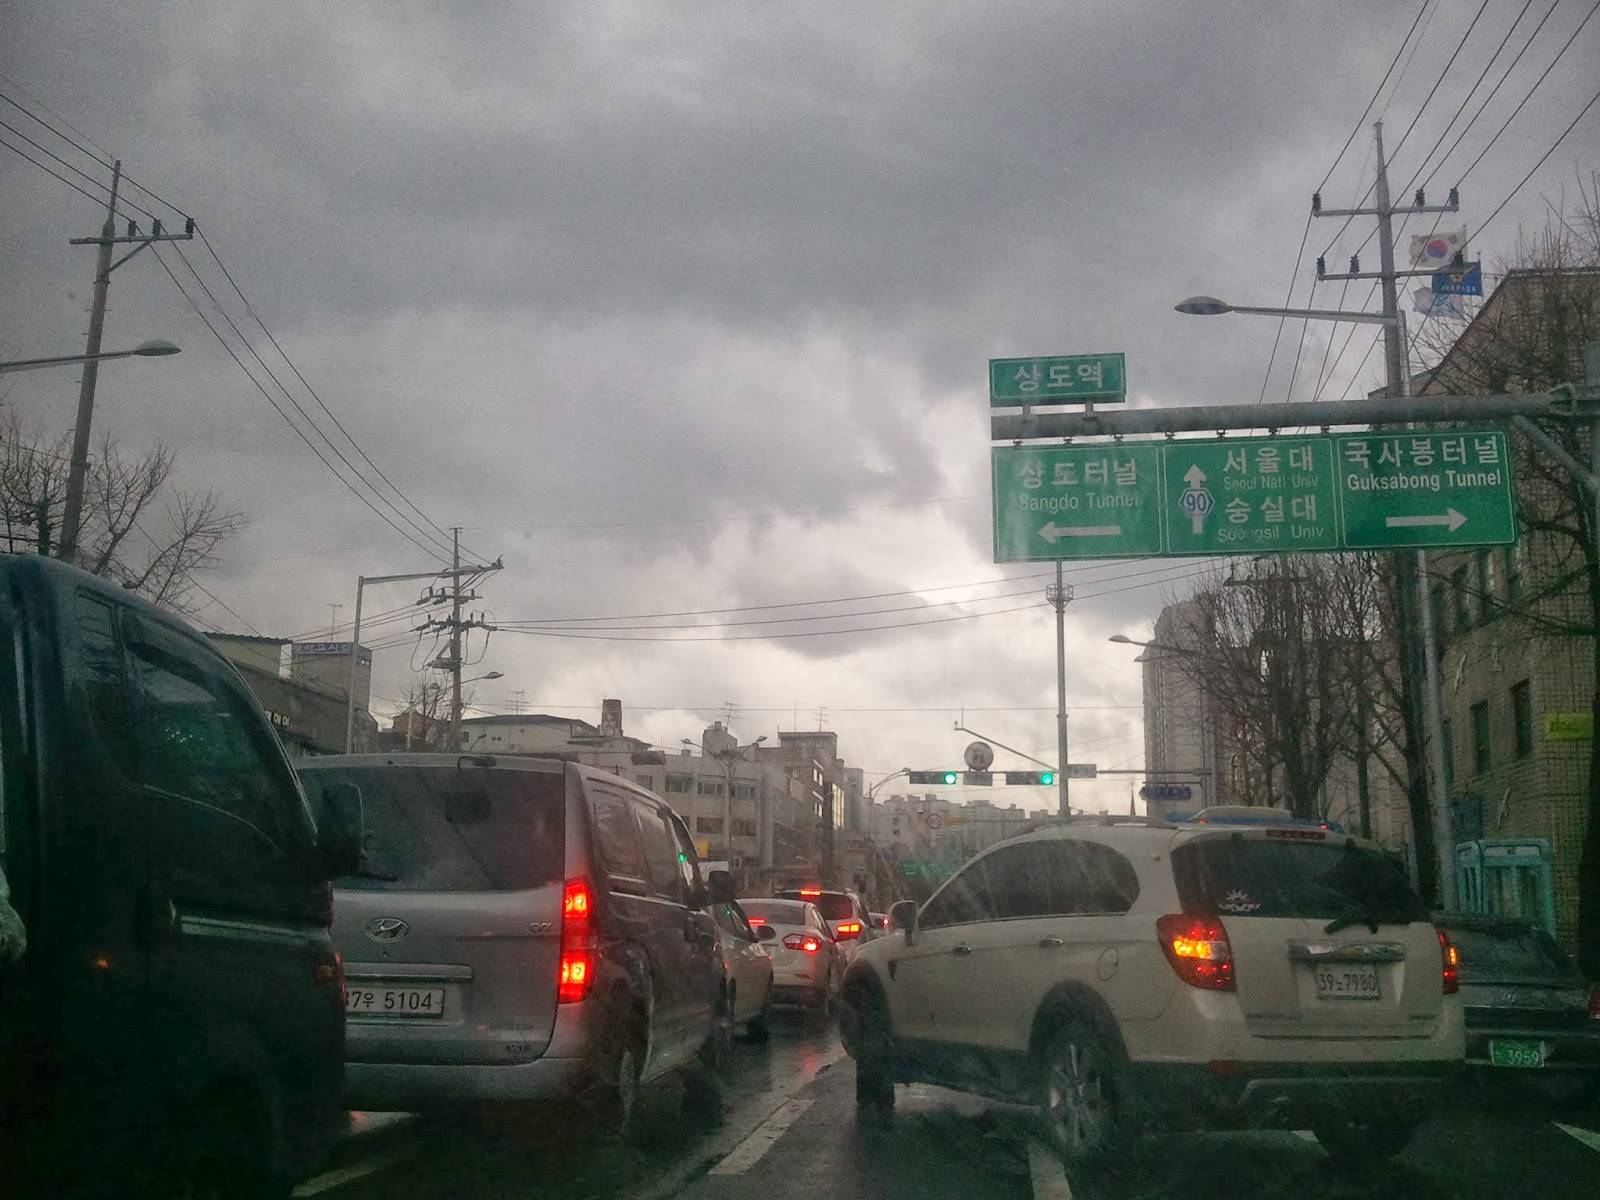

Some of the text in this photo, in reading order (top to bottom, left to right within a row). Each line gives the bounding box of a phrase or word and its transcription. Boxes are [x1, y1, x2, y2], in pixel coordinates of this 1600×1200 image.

[1014, 362, 1102, 392] 상도역
[1223, 446, 1313, 474] 서울대
[1345, 435, 1499, 469] 국사봉터널
[1018, 458, 1137, 489] 상도터널
[1223, 476, 1257, 490] Seoul
[1292, 474, 1319, 488] Univ
[1347, 469, 1501, 492] Guksabong Tunnel
[1018, 489, 1139, 514] Sangdo Tunnel
[1186, 493, 1206, 512] 90
[1225, 494, 1317, 524] 숭실대
[1291, 524, 1325, 539] Univ
[384, 991, 433, 1010] 5104
